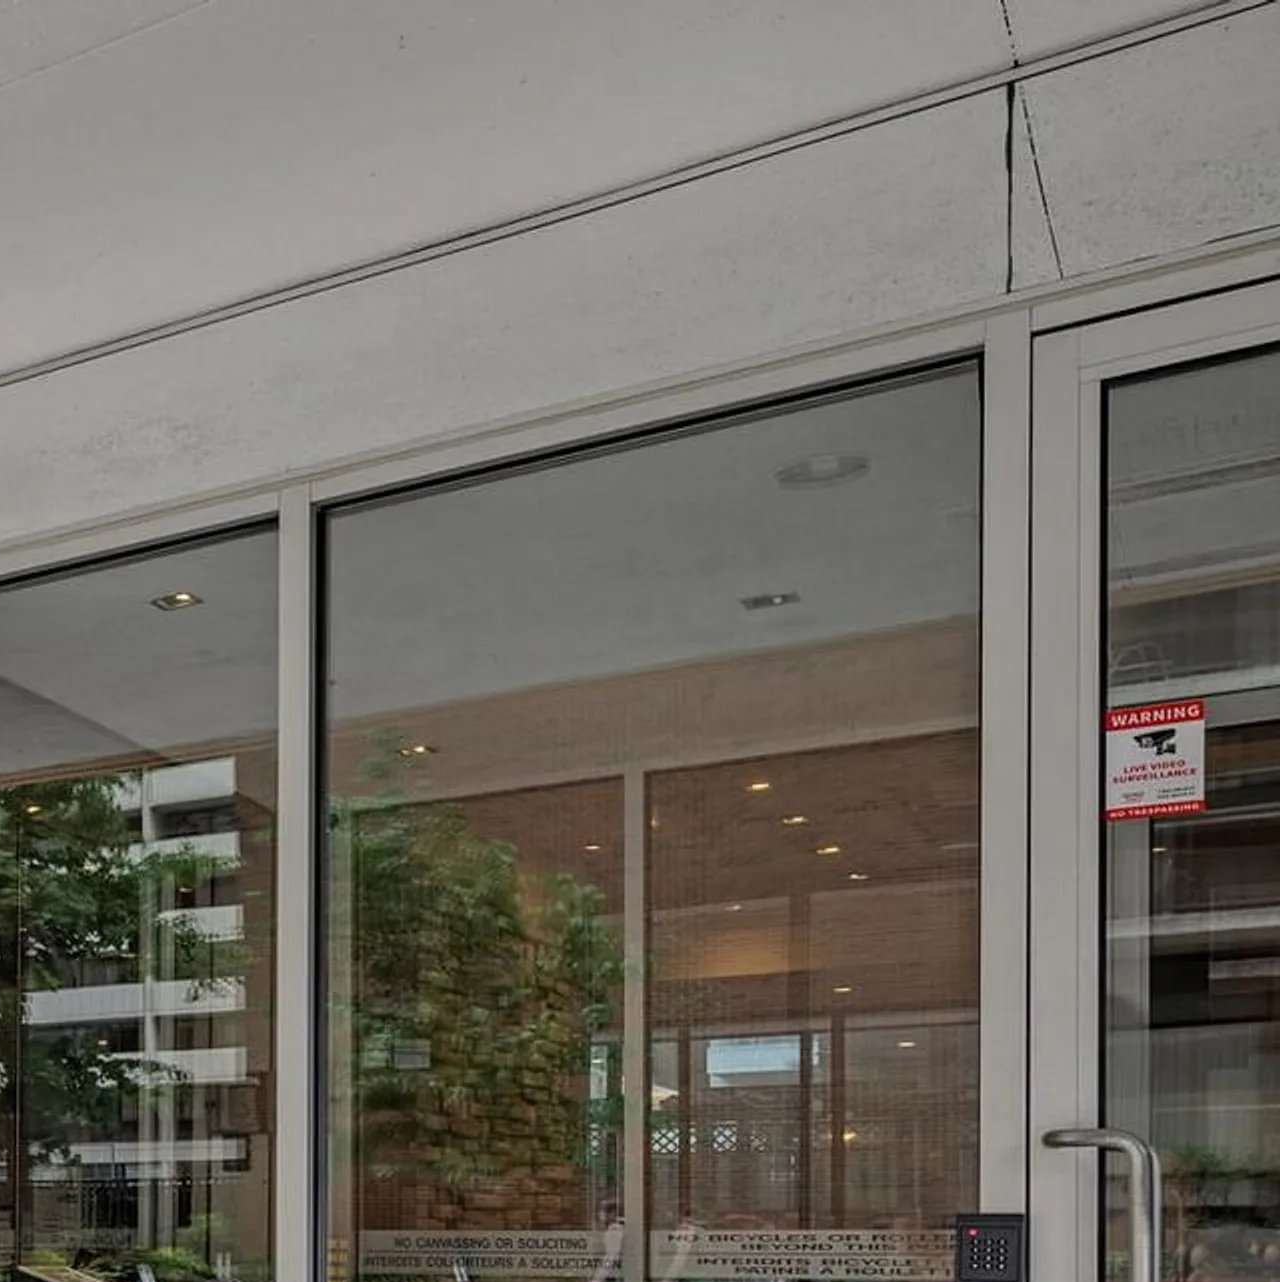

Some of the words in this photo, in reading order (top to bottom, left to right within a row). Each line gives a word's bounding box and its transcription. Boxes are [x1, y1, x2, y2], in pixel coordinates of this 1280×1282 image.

[1111, 704, 1200, 727] WARNING
[1124, 764, 1146, 774] LIVE
[1150, 760, 1185, 771] VIDEO
[1113, 768, 1197, 784] SURVEILLANCE
[394, 1238, 411, 1249] NO
[416, 1238, 490, 1249] CANVASSING
[495, 1238, 514, 1249] OR
[518, 1237, 588, 1249] SOLICITING
[667, 1233, 698, 1243] NO
[708, 1233, 817, 1243] BICYCLES
[827, 1233, 861, 1243] OR
